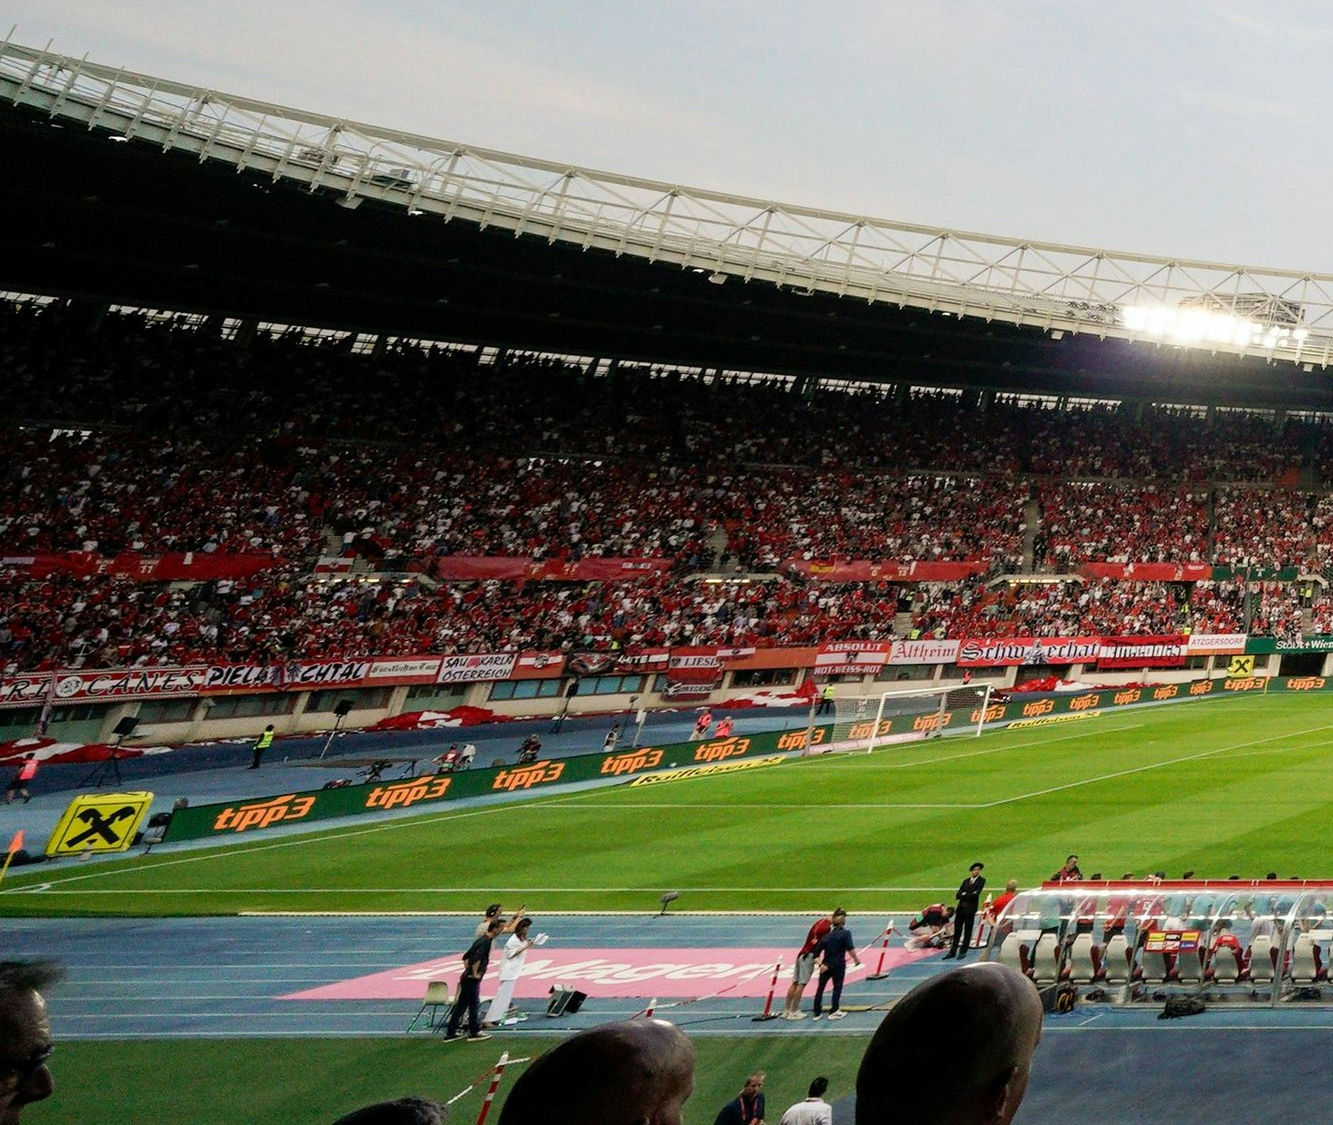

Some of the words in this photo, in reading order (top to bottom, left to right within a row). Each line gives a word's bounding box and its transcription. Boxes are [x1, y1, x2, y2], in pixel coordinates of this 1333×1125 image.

[823, 642, 884, 653] ABSOLUT
[1153, 685, 1178, 700] tipp3
[1189, 680, 1213, 696] tipp3
[1224, 676, 1265, 692] tipp3
[1287, 676, 1326, 691] tipp3
[1069, 693, 1099, 712] tipp3
[1113, 688, 1141, 705] tipp3
[1022, 699, 1055, 717] tipp3
[694, 735, 751, 762] tipp3
[600, 747, 664, 776] tipp3
[492, 760, 565, 791] tipp3
[365, 775, 452, 809] tipp3
[213, 794, 315, 832] tipp3
